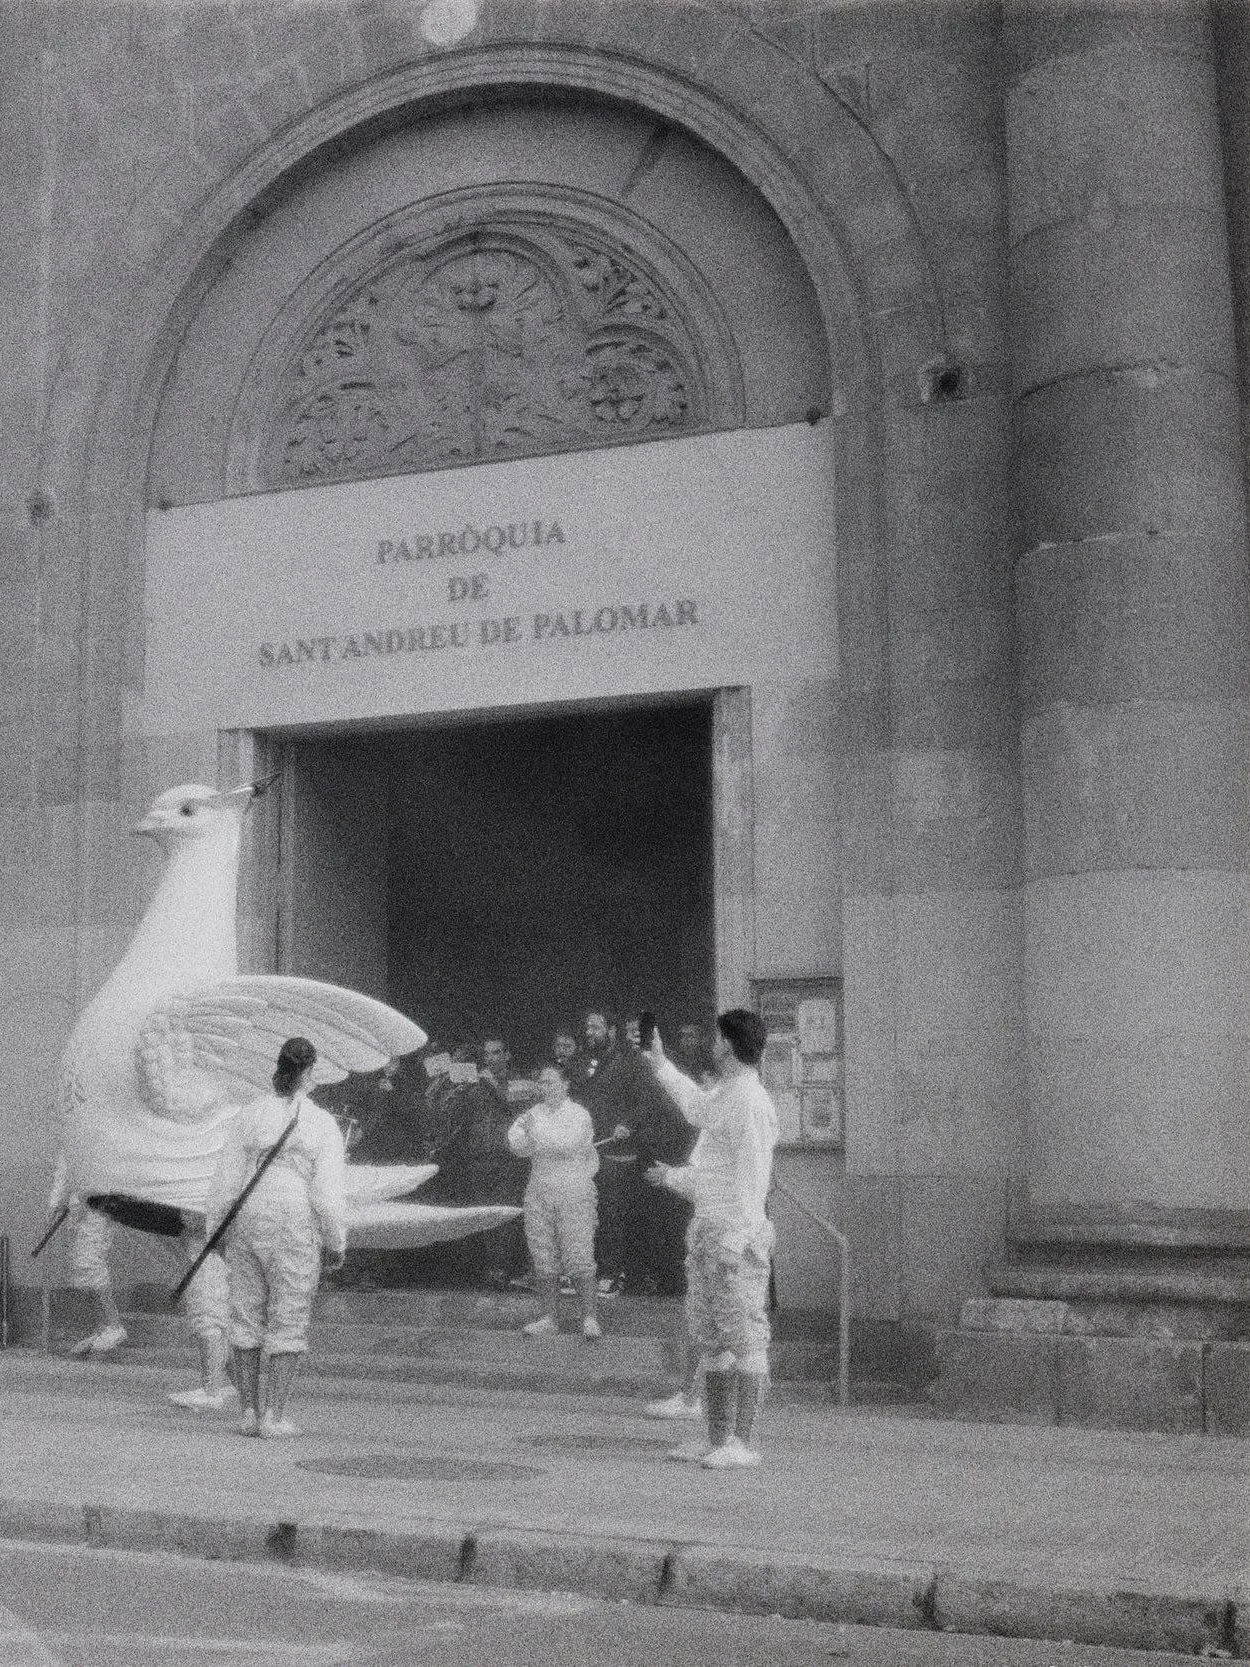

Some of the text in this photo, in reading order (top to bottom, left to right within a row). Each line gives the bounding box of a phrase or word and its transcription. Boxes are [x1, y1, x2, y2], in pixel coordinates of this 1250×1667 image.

[376, 520, 566, 564] PARRÒQUIA
[447, 573, 490, 602] DE
[259, 599, 699, 667] SANT ANDREU DE PALOMAR
